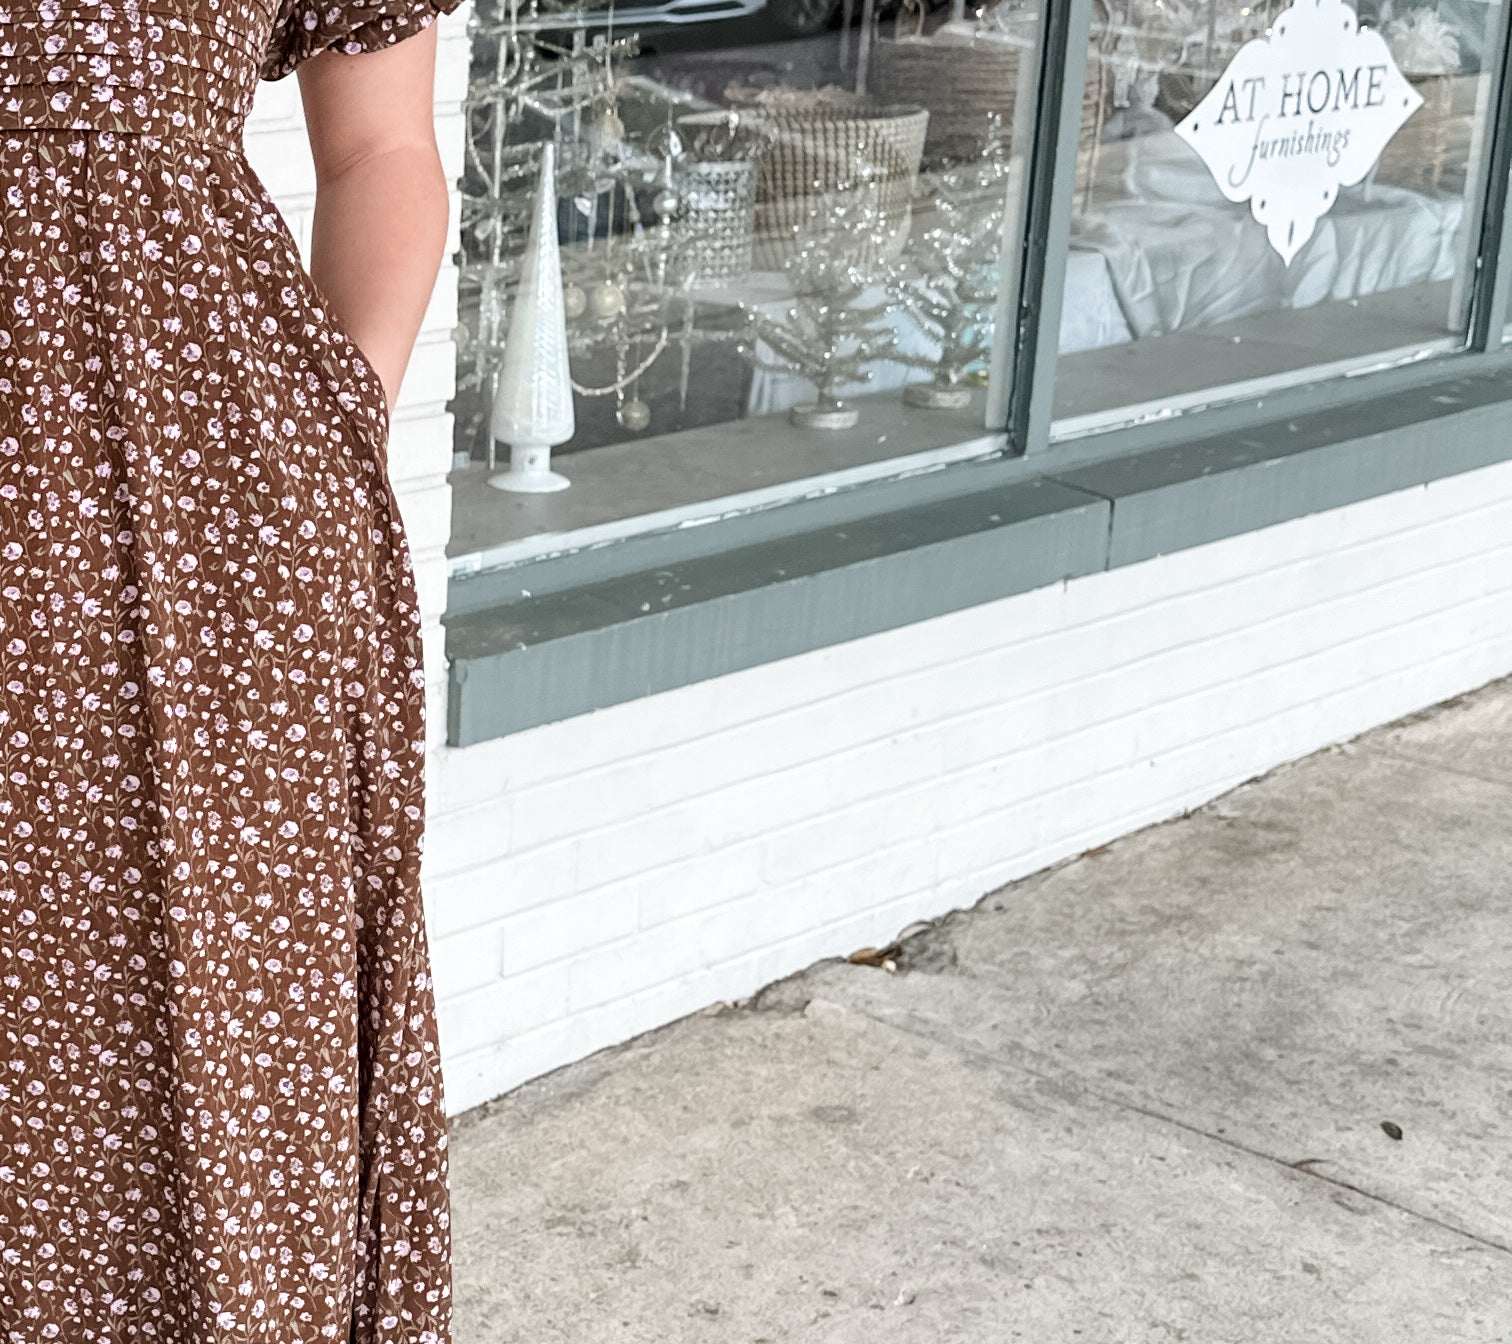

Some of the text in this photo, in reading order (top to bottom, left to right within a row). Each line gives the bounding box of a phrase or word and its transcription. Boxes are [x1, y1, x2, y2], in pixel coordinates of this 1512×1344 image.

[1215, 65, 1387, 125] AT HOME
[1228, 113, 1350, 188] furnishings
